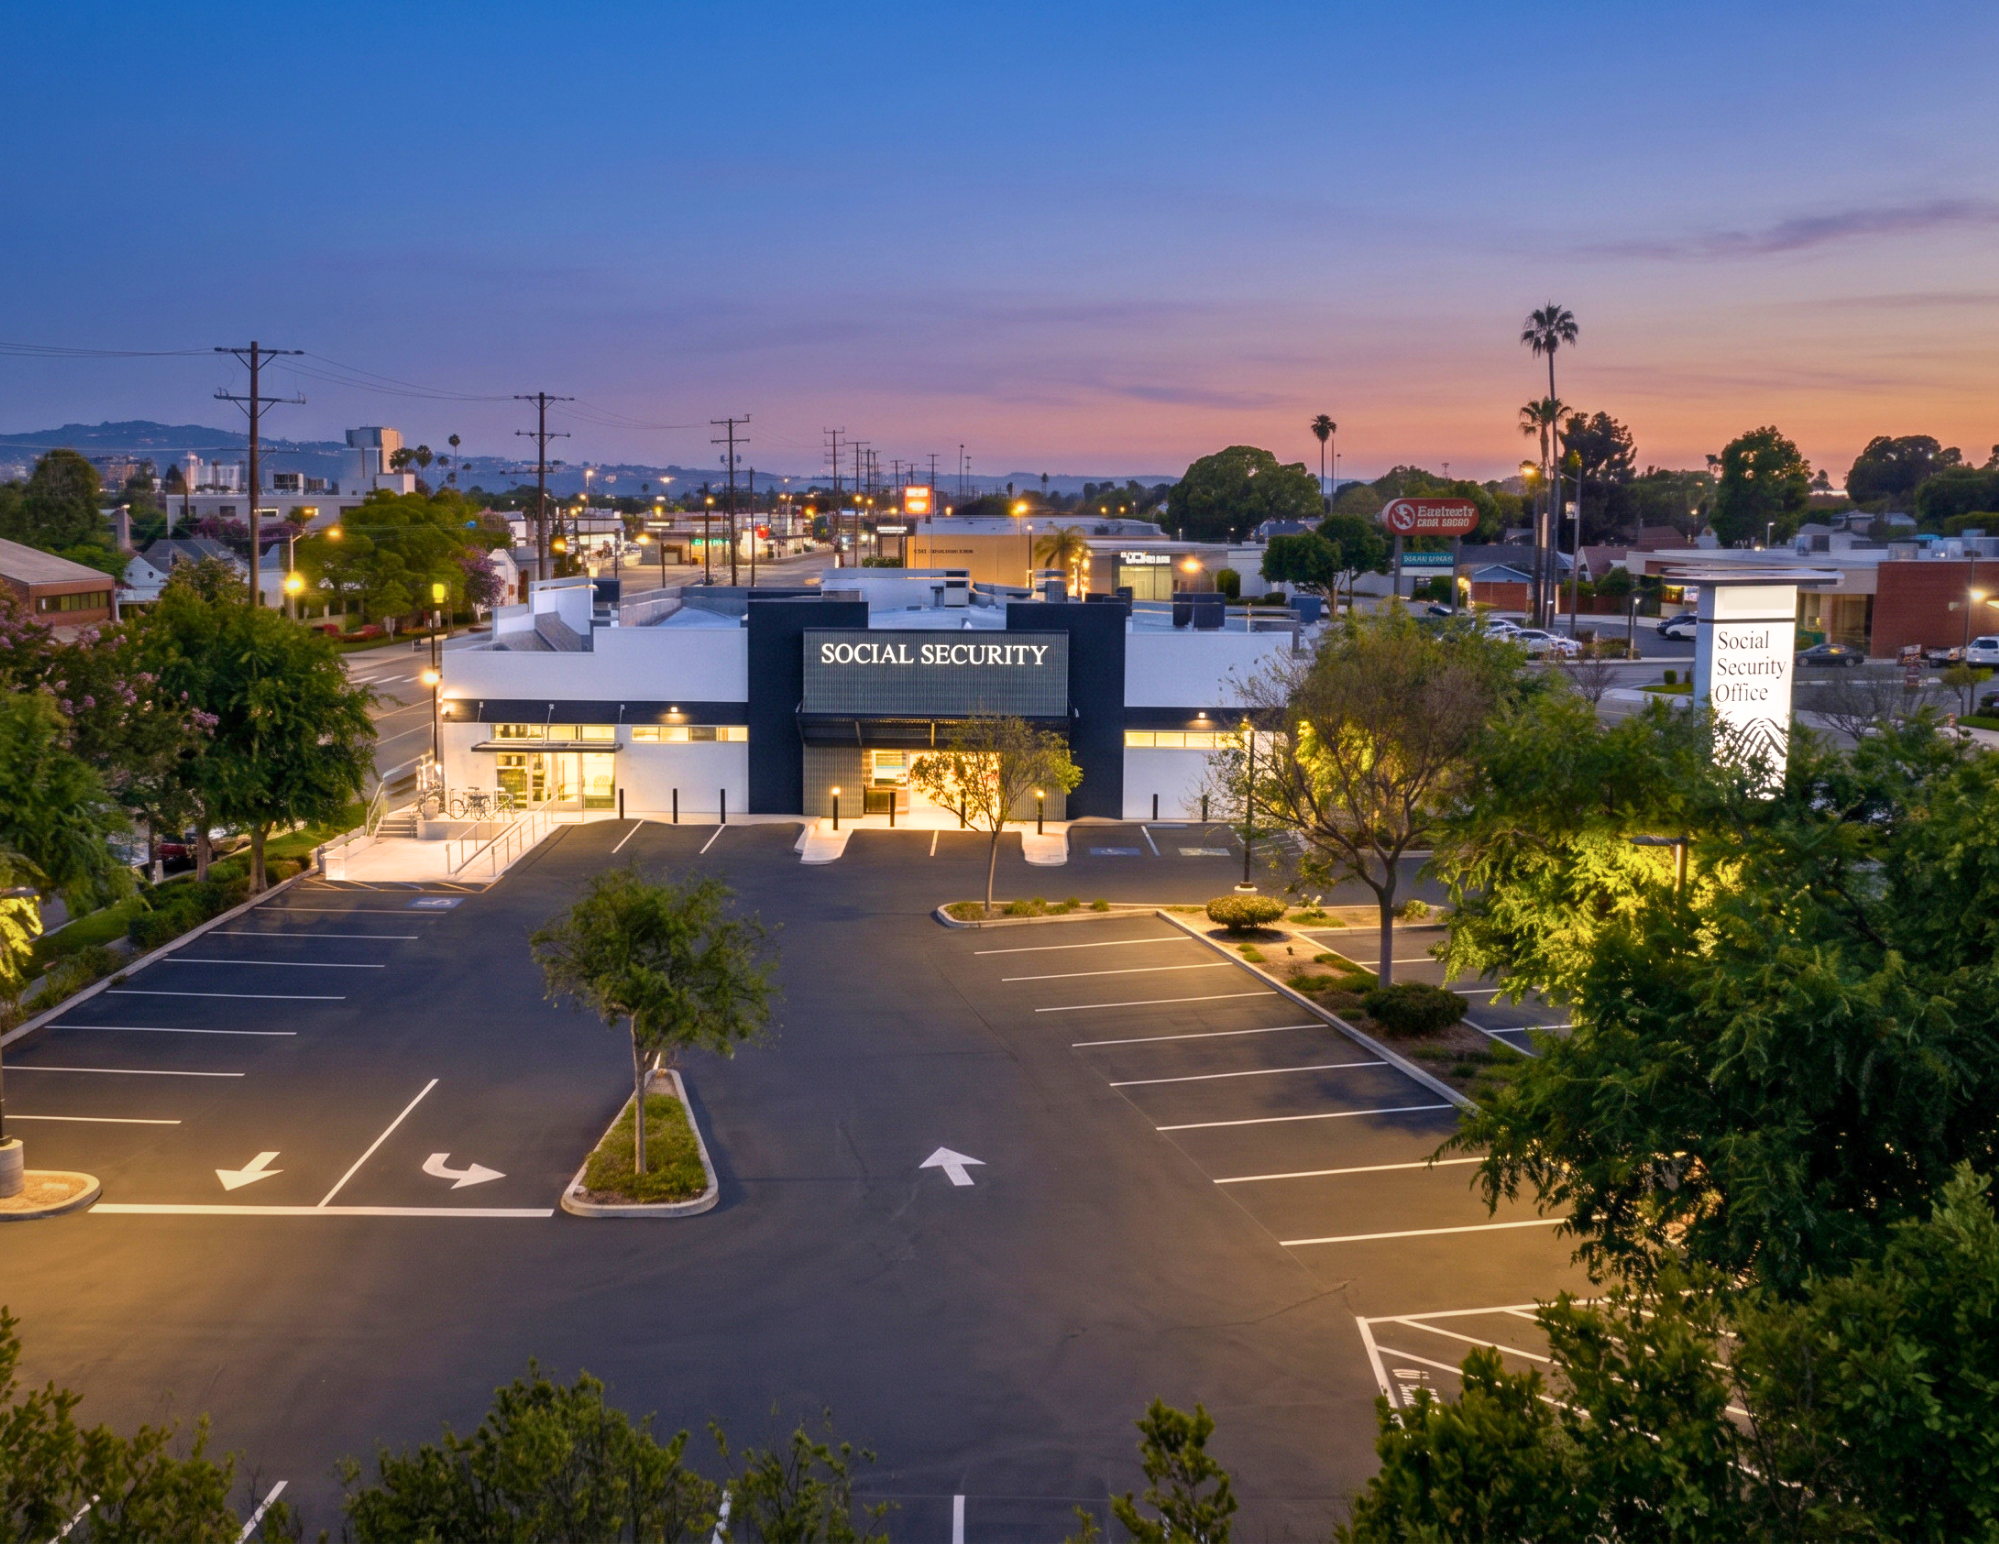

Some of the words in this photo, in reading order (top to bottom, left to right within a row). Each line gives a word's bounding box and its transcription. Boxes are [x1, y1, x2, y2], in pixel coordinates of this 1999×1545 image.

[1717, 630, 1769, 650] Social
[821, 643, 914, 664] SOCIAL
[920, 644, 1049, 665] SECURITY
[1716, 655, 1787, 680] Security
[1715, 682, 1769, 702] Office
